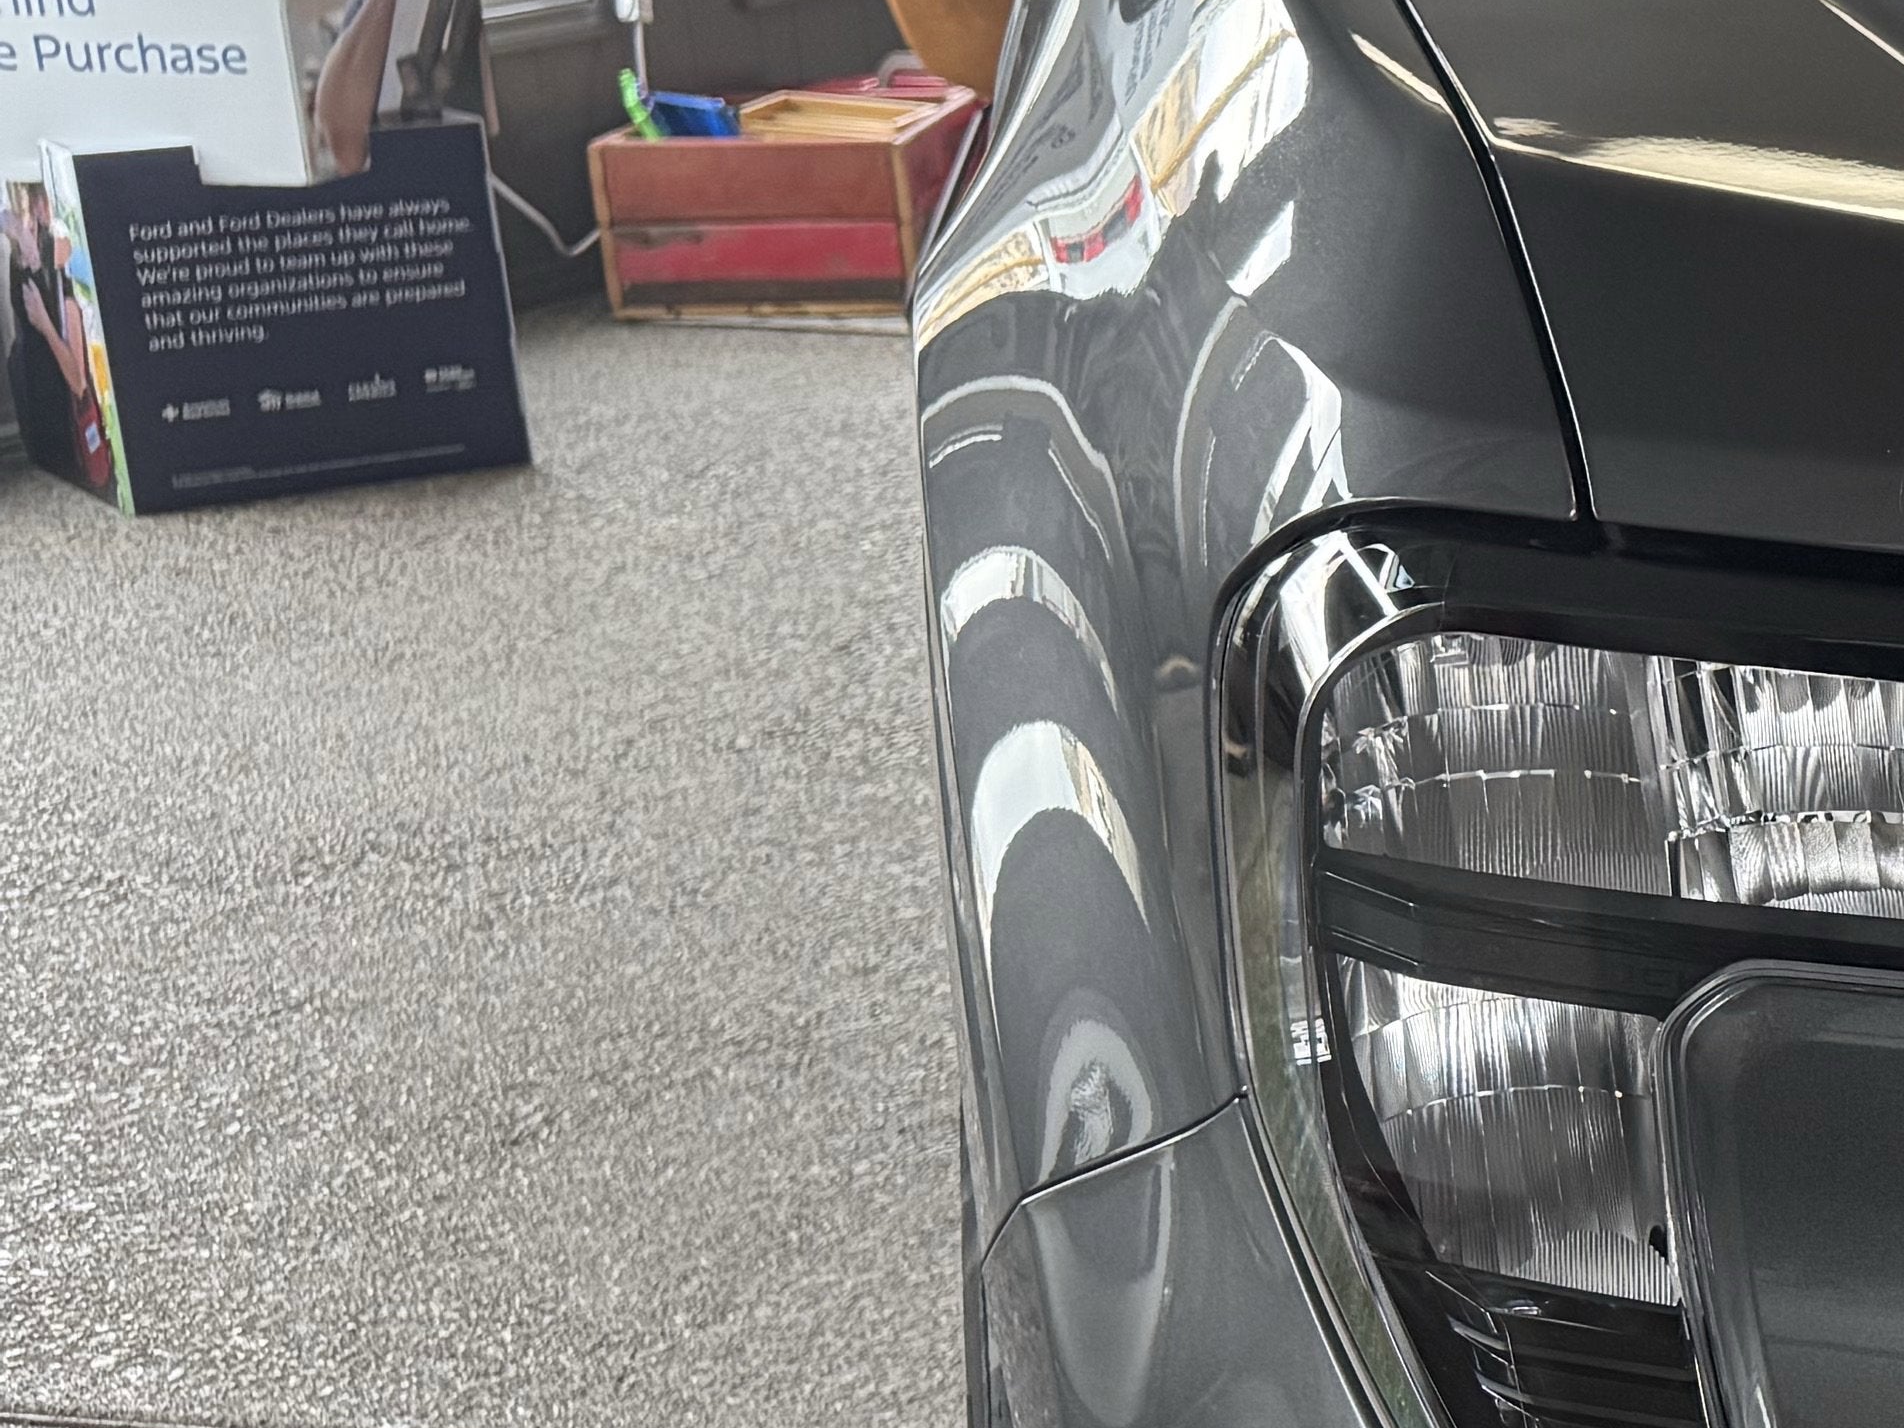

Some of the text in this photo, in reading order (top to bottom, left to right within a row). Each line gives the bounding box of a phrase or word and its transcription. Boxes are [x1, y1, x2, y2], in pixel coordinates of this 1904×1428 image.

[33, 31, 248, 75] Purchase
[128, 198, 450, 243] Ford and Ford Dealers have always
[133, 236, 231, 264] supported
[238, 233, 268, 253] the
[274, 229, 333, 252] places
[338, 223, 378, 243] they
[383, 220, 413, 239] call
[136, 239, 454, 287] We're proud to team up with these
[141, 261, 444, 309] amazing organizations to ensure
[145, 278, 466, 330] that our communities are prepared
[149, 330, 185, 352] and
